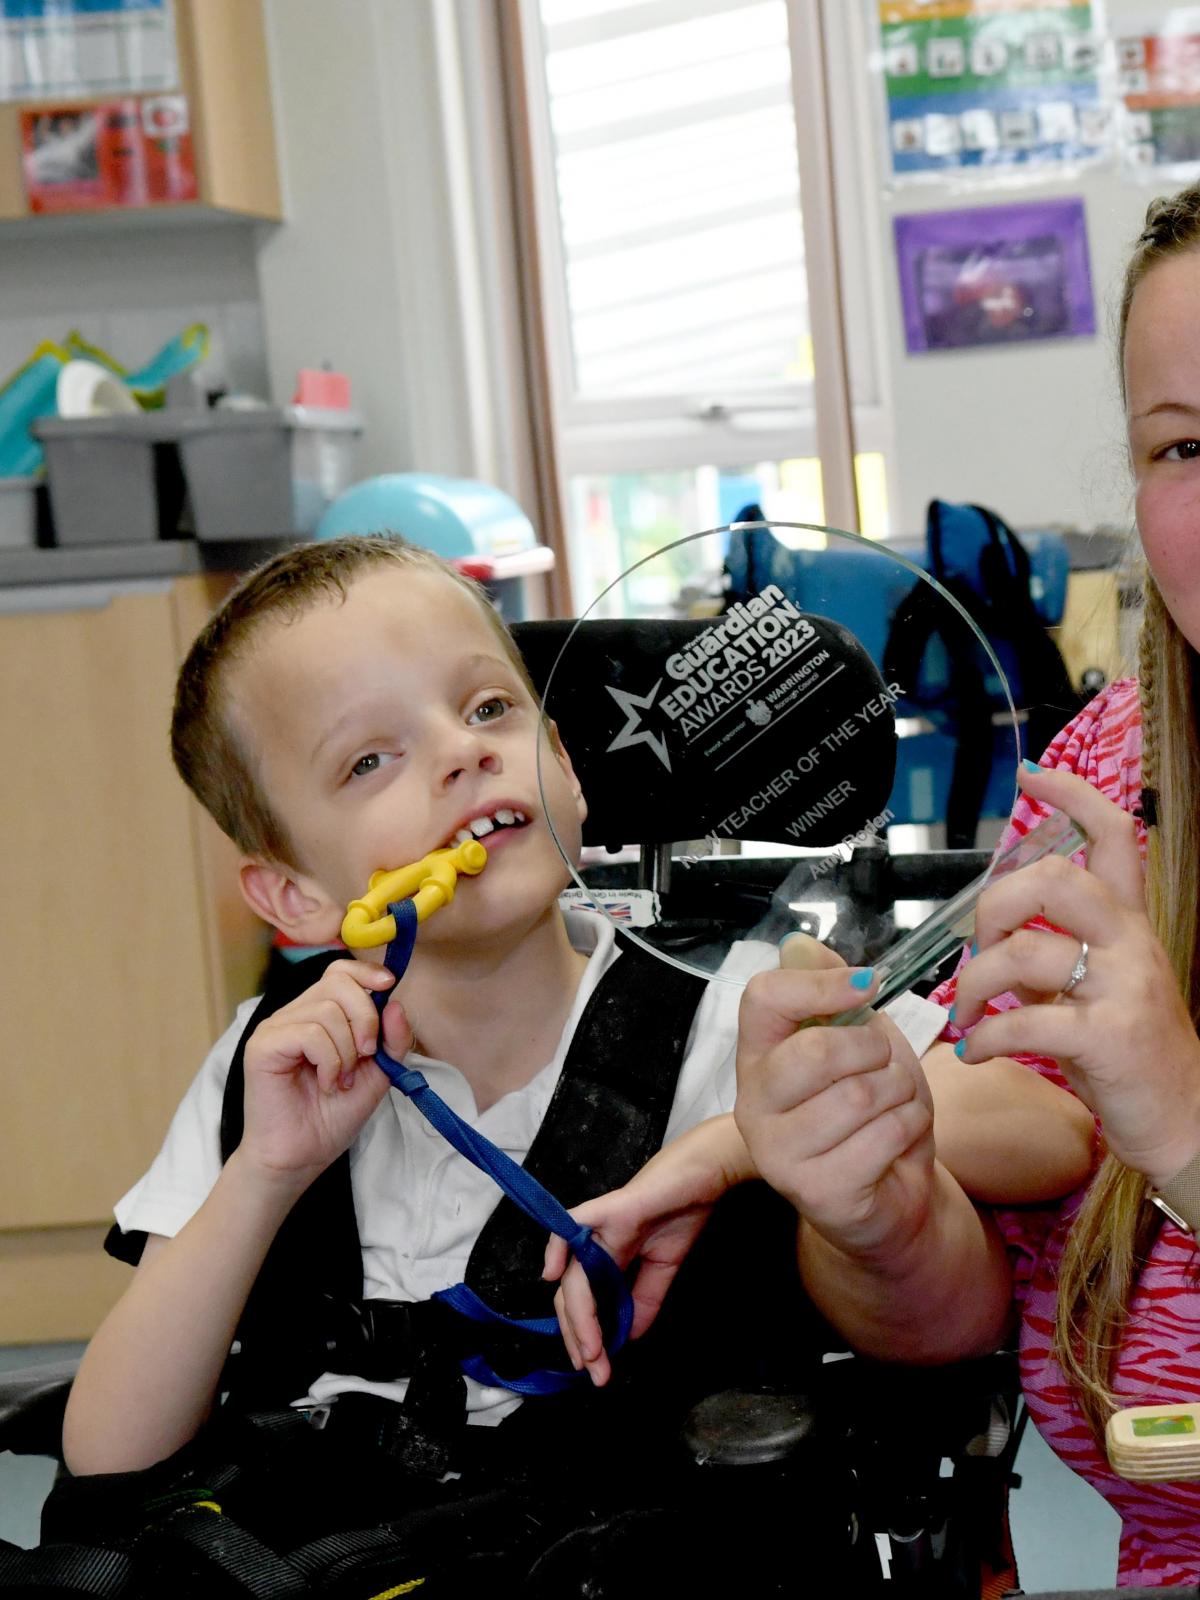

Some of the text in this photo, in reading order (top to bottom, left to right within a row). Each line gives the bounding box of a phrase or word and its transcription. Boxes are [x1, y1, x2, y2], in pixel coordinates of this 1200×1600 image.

[658, 598, 801, 721] EDUCATION
[665, 584, 785, 680] Guardian
[679, 619, 816, 738] AWARDS 2023
[717, 768, 800, 835] TEACHER
[797, 747, 823, 773] OF
[820, 718, 861, 753] THE
[854, 681, 907, 725] YEAR
[785, 780, 857, 838] WINNER
[809, 808, 895, 880] Amy Roden
